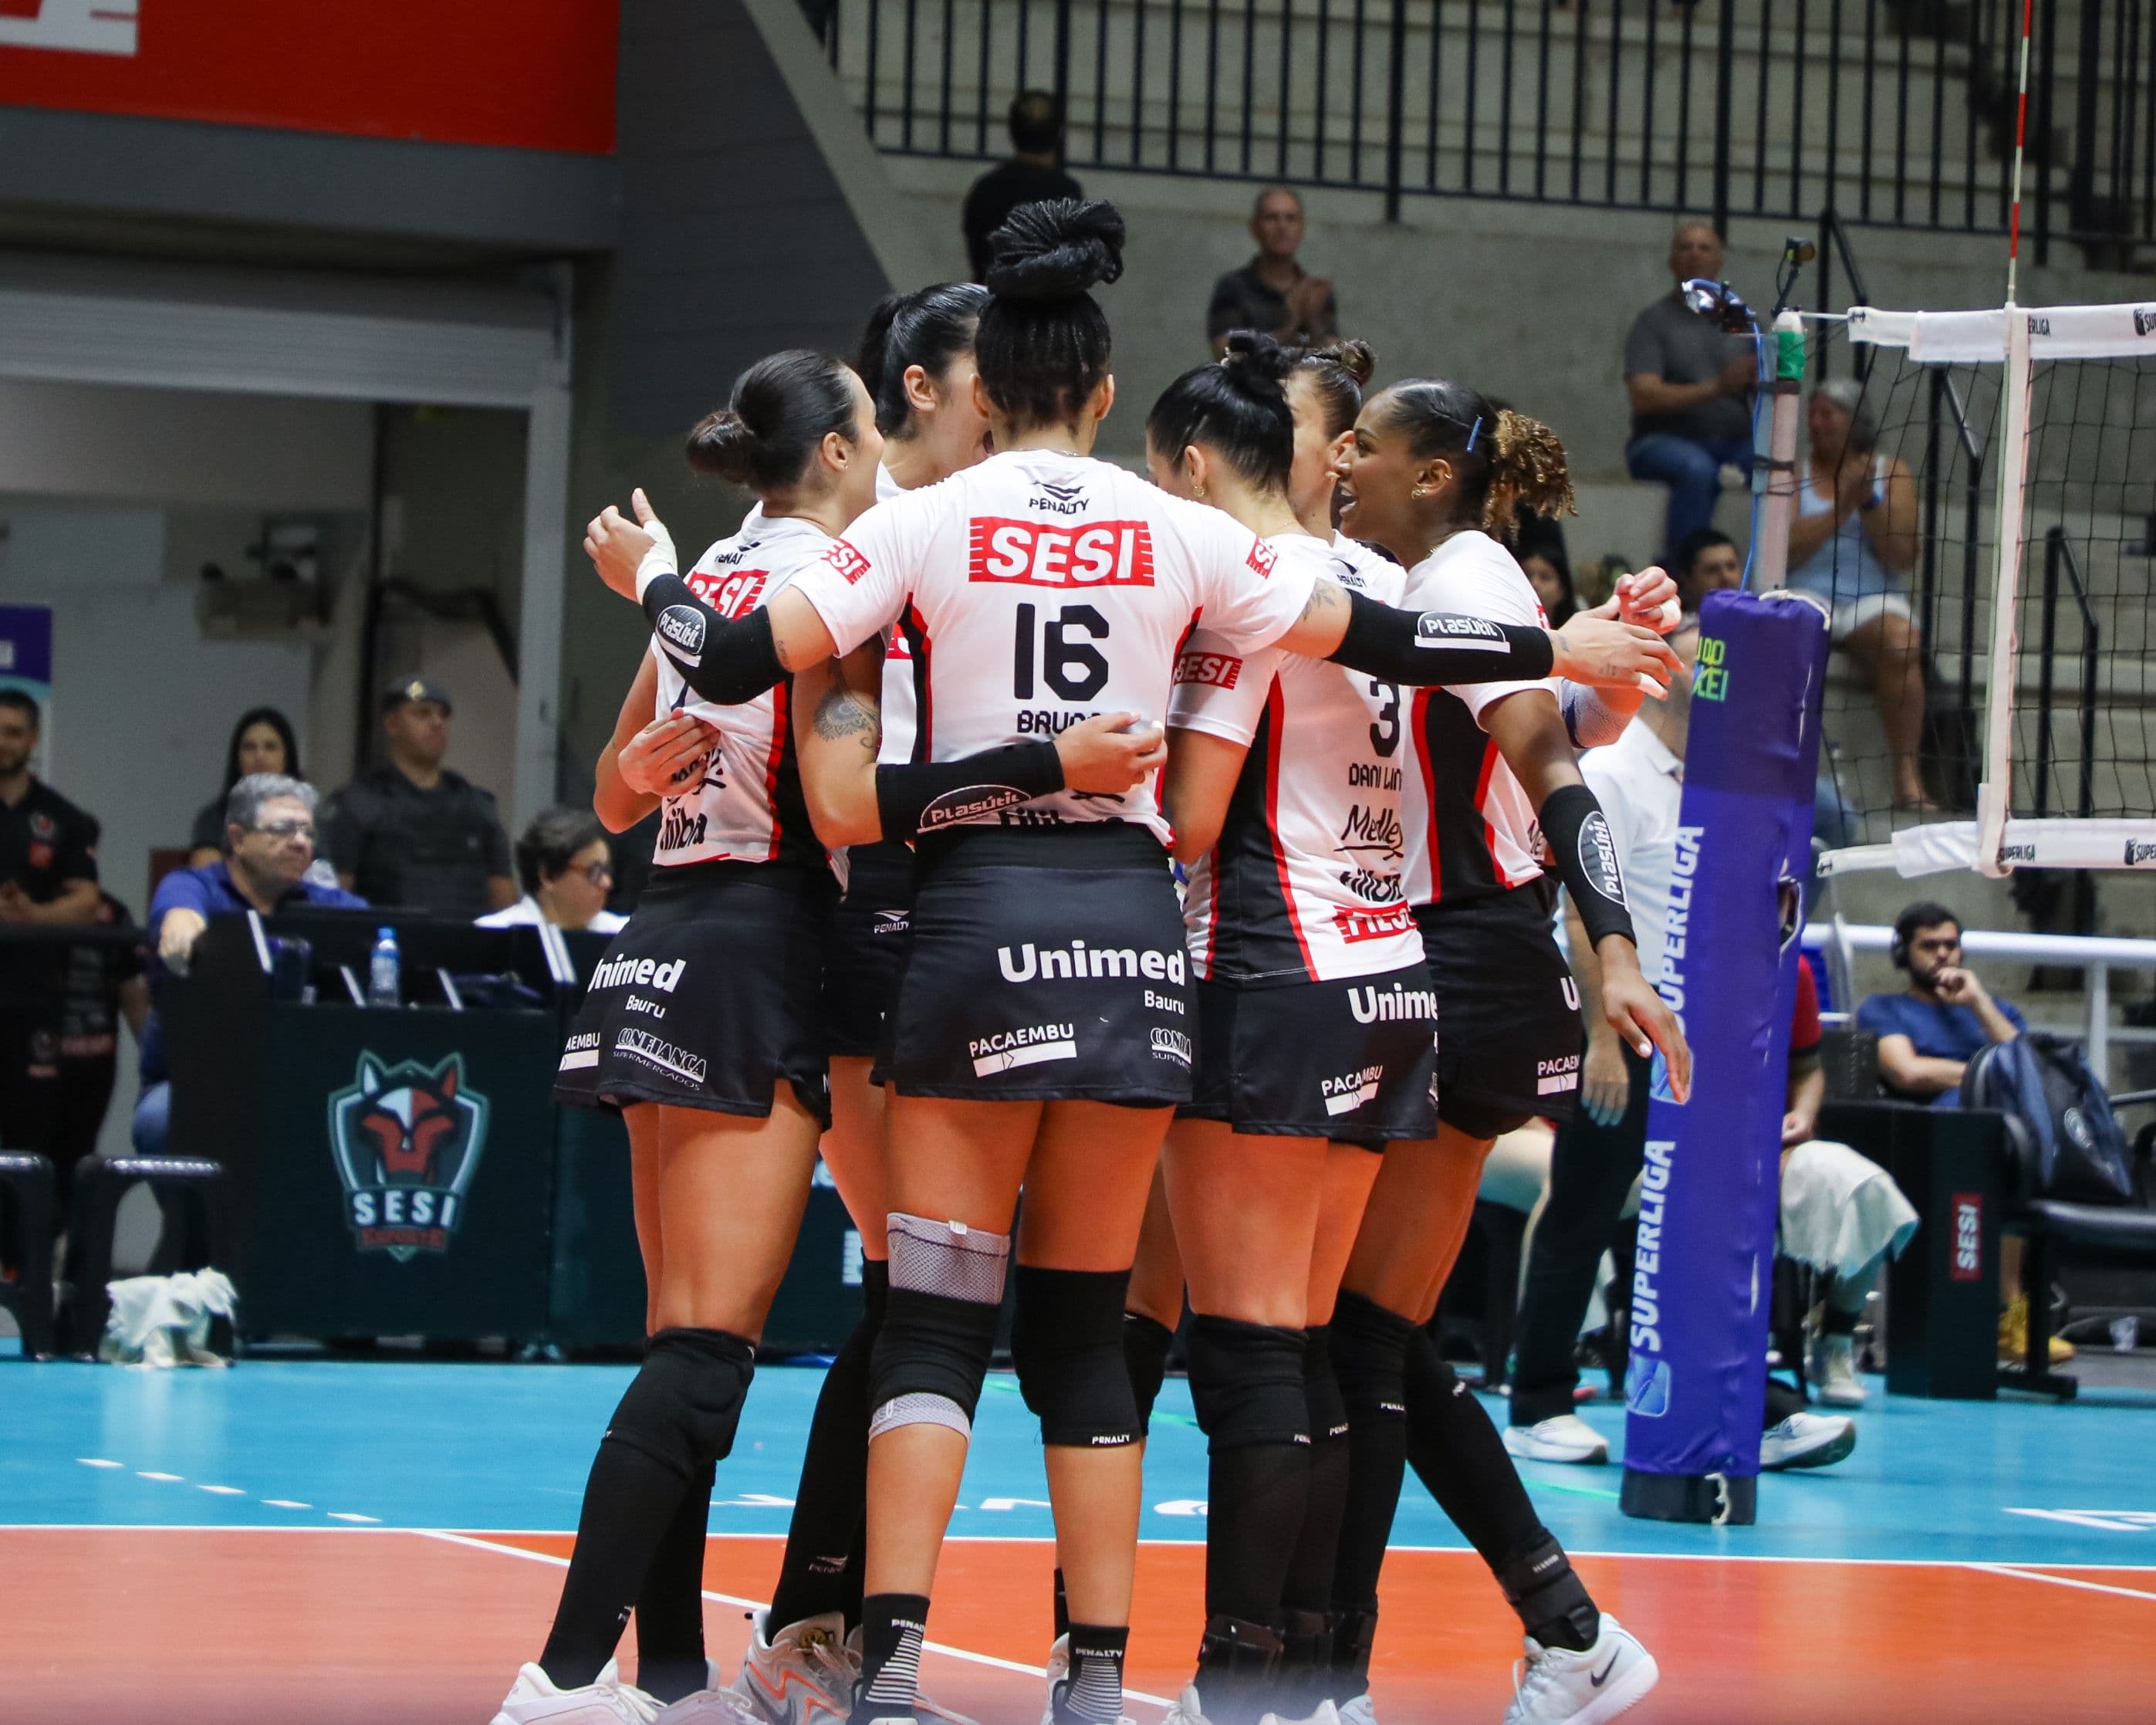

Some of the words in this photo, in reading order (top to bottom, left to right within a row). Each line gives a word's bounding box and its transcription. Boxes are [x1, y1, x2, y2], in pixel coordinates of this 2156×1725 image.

[1029, 498, 1090, 514] PENALTY
[986, 526, 1135, 583] SESI
[1014, 603, 1110, 702] 16
[1370, 680, 1400, 757] 3
[1349, 763, 1381, 788] DANI
[2135, 843, 2156, 862] SUPE
[874, 921, 909, 934] PENALTY
[998, 939, 1185, 986] Unimed
[626, 994, 666, 1019] Bauru
[1144, 989, 1184, 1015] Bauru
[969, 1023, 1074, 1057] PACAEMBU
[1321, 1065, 1383, 1097] PACAMBU
[353, 1190, 456, 1227] SESI
[1630, 1141, 1677, 1353] SUPERLIGA
[1956, 1204, 1979, 1272] SESI
[1092, 1434, 1130, 1444] PENALTY
[1075, 1648, 1124, 1658] PENALTY
